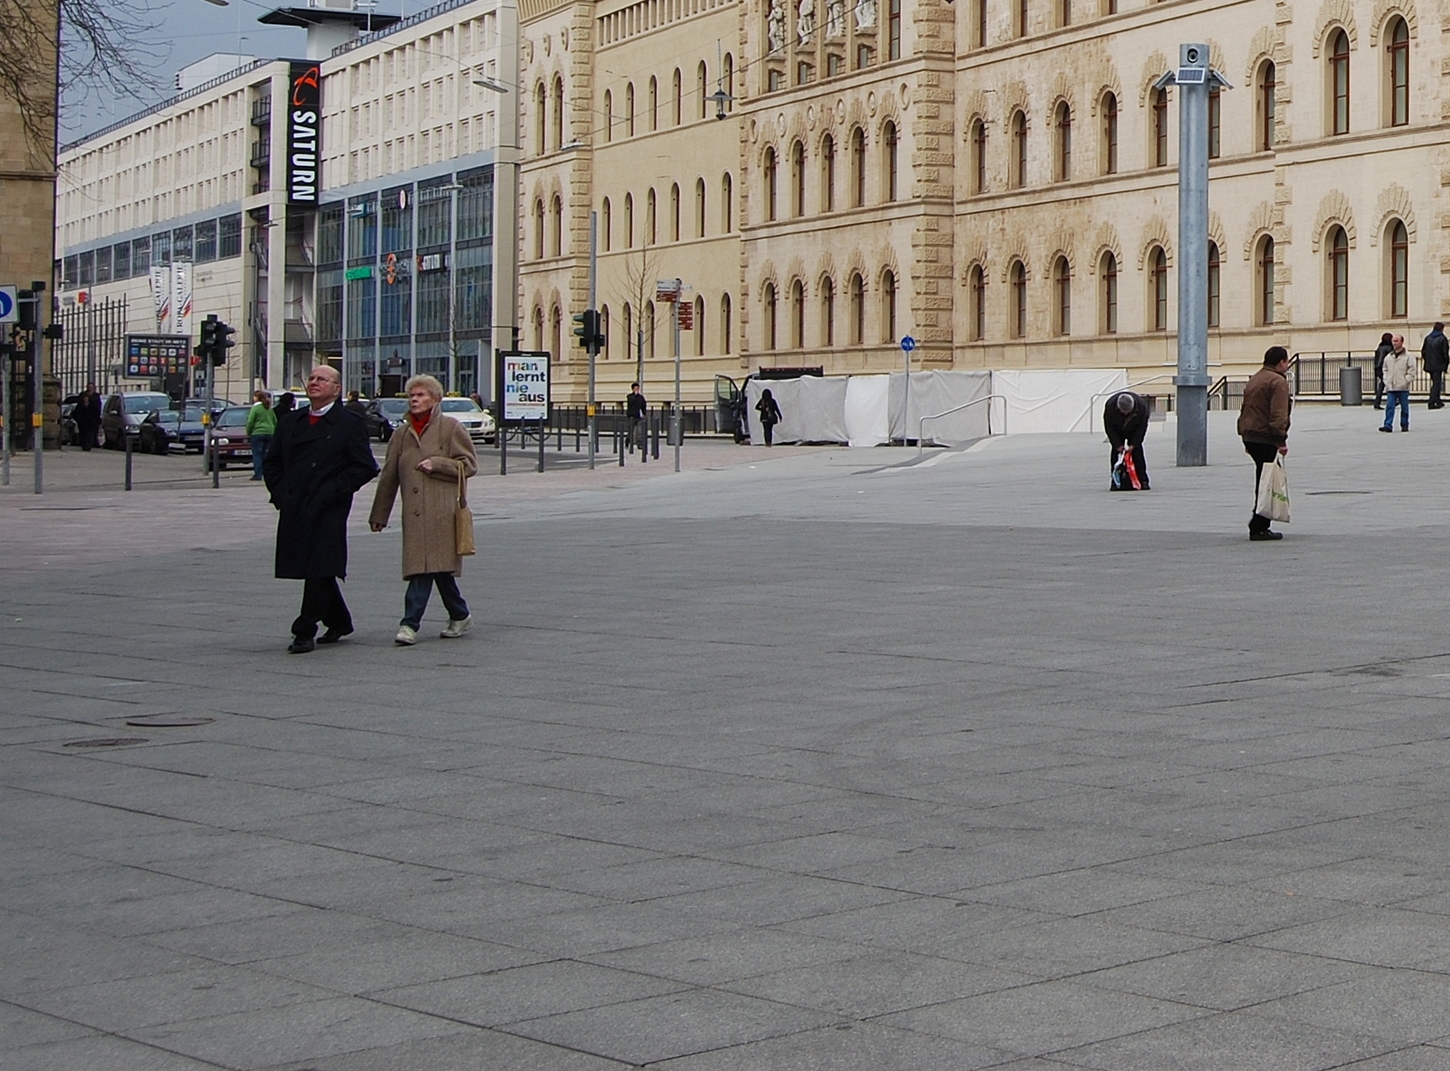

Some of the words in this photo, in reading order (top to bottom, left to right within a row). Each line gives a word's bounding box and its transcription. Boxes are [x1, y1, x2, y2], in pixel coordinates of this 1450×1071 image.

[292, 110, 317, 201] SATURN
[507, 362, 538, 371] man
[512, 371, 546, 382] lernt
[506, 382, 529, 393] nie
[518, 393, 545, 402] aus
